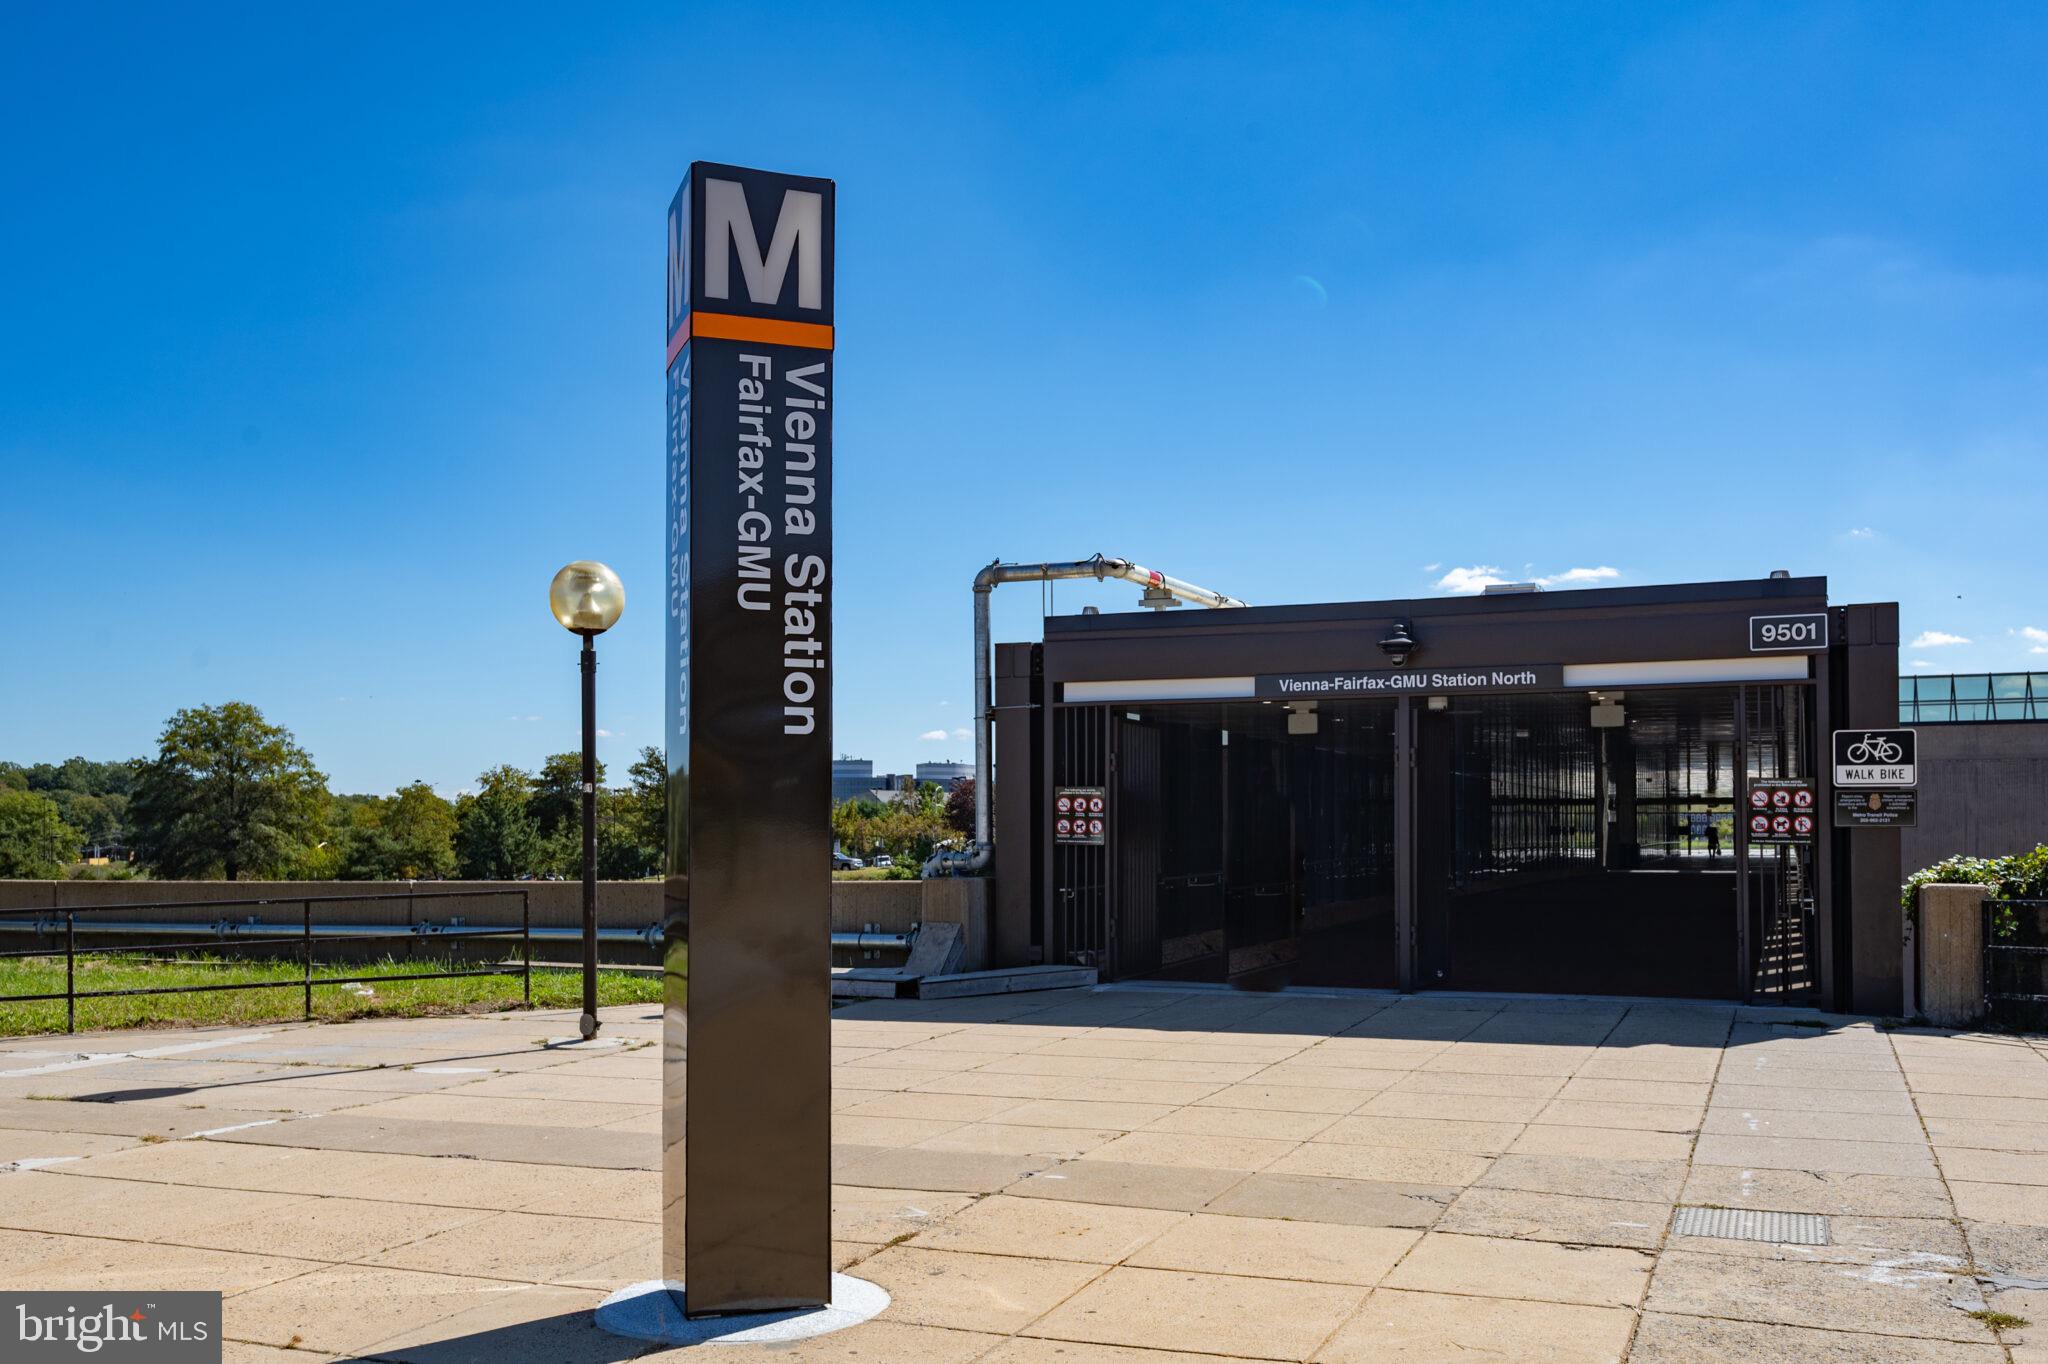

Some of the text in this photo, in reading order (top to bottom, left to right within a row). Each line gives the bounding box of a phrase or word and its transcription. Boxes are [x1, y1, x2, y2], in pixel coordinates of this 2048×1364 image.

[669, 182, 691, 331] M
[704, 177, 822, 311] M
[671, 366, 680, 618] Fairfax-GMU
[679, 353, 690, 735] Vienna Station
[737, 353, 772, 611] Fairfax-GMU
[783, 362, 826, 735] Vienna Station
[1279, 671, 1536, 692] Vienna-Fairfax-GMU Station North
[1761, 622, 1816, 642] 9501
[1845, 768, 1905, 780] WALK BIKE
